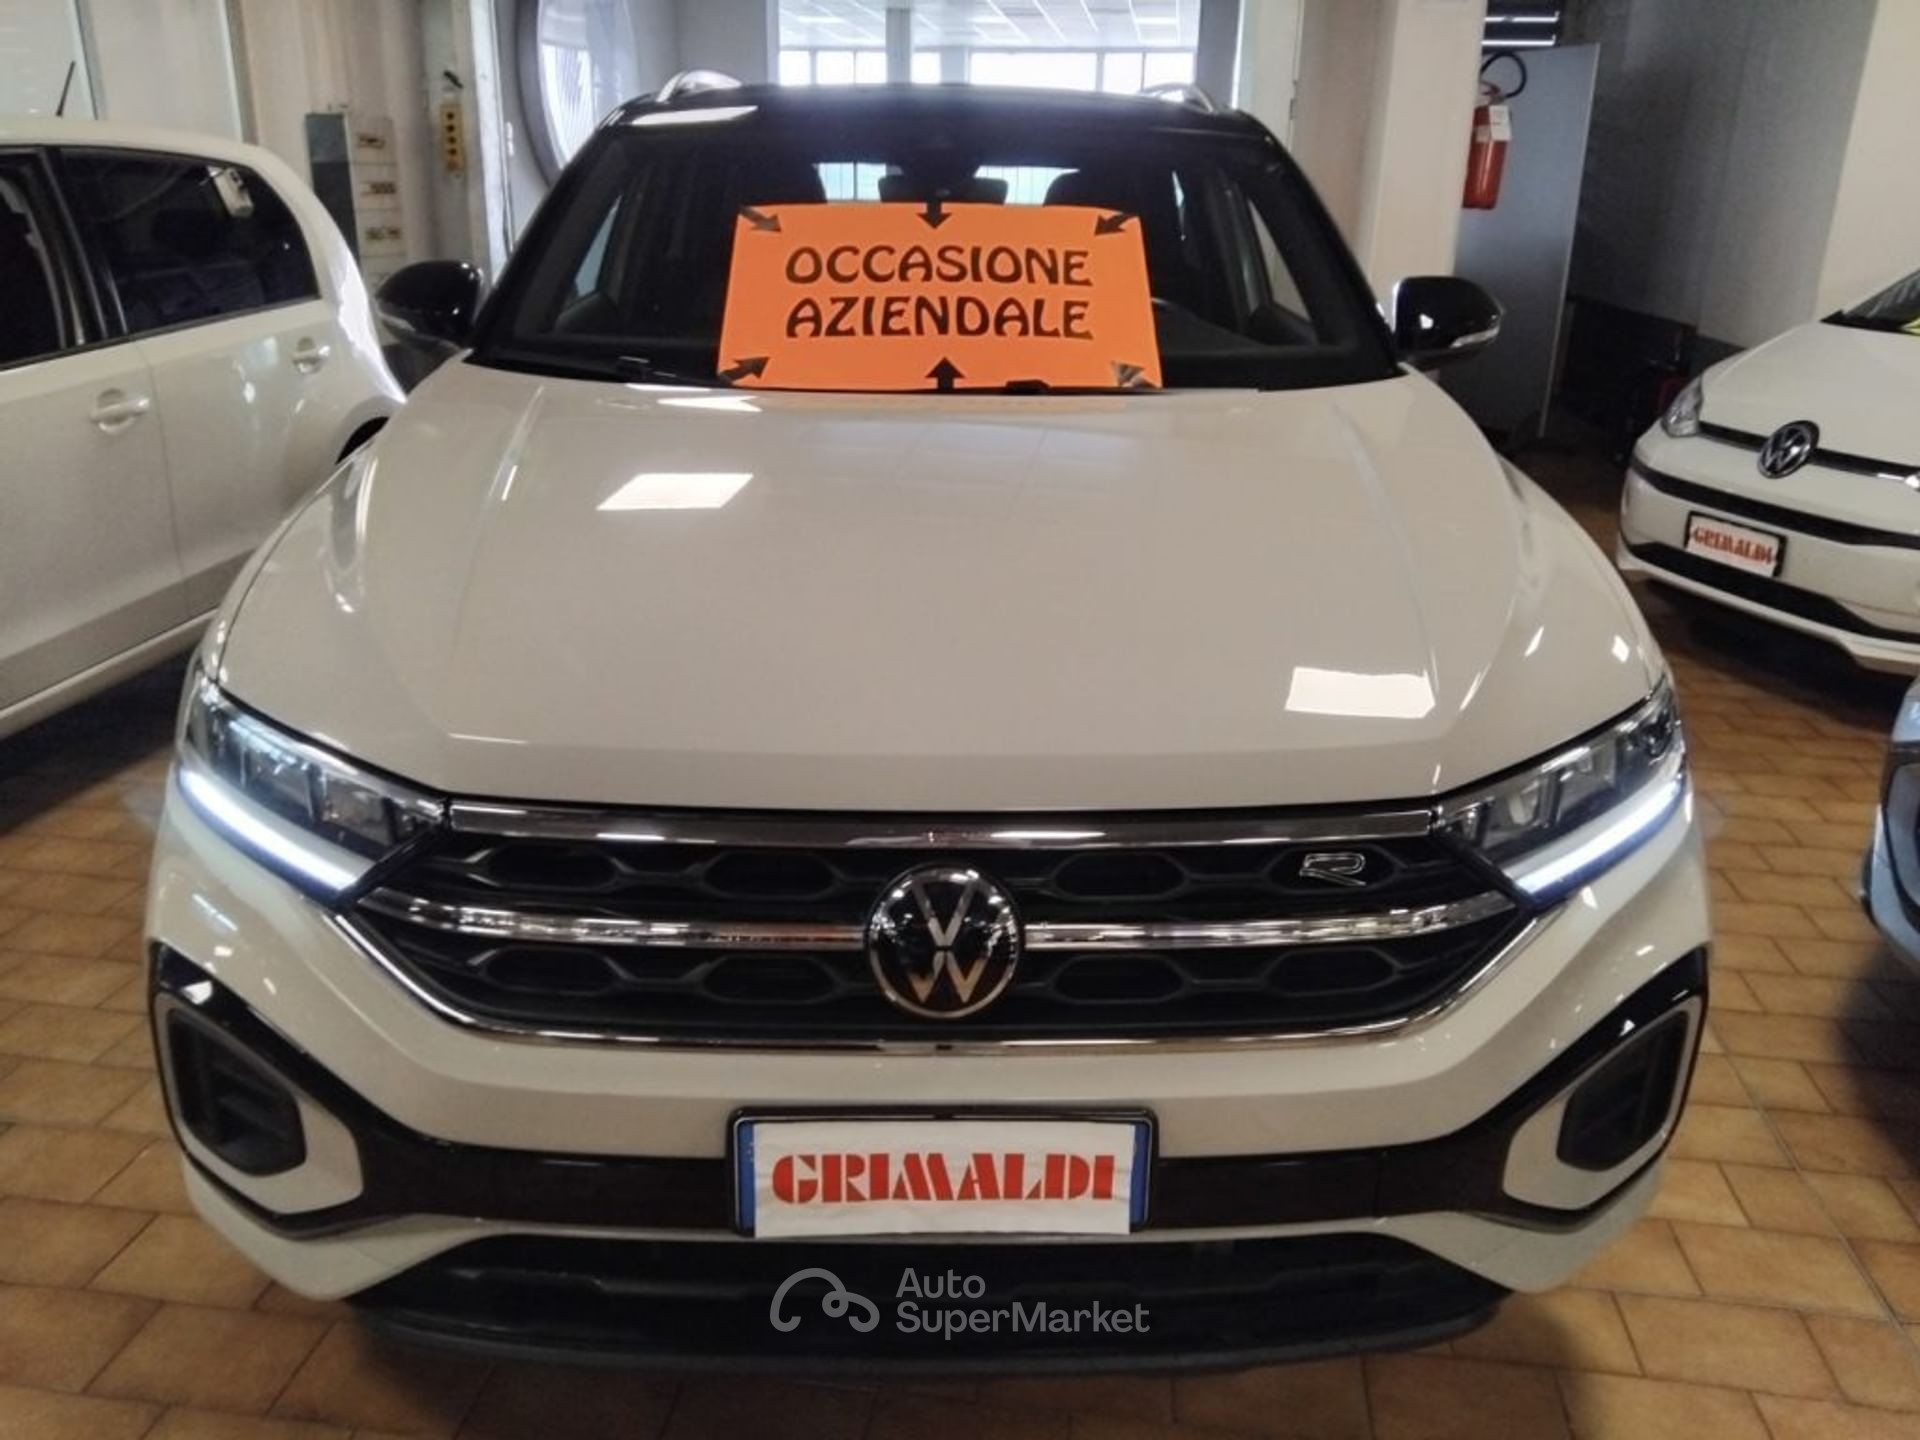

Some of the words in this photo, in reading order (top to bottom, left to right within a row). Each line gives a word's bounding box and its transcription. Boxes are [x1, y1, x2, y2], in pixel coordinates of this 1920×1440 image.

[785, 245, 1093, 286] OCCASIONE
[785, 296, 1093, 340] AZIENDALE
[1299, 853, 1367, 886] R
[772, 1152, 1115, 1204] GRIMALDI
